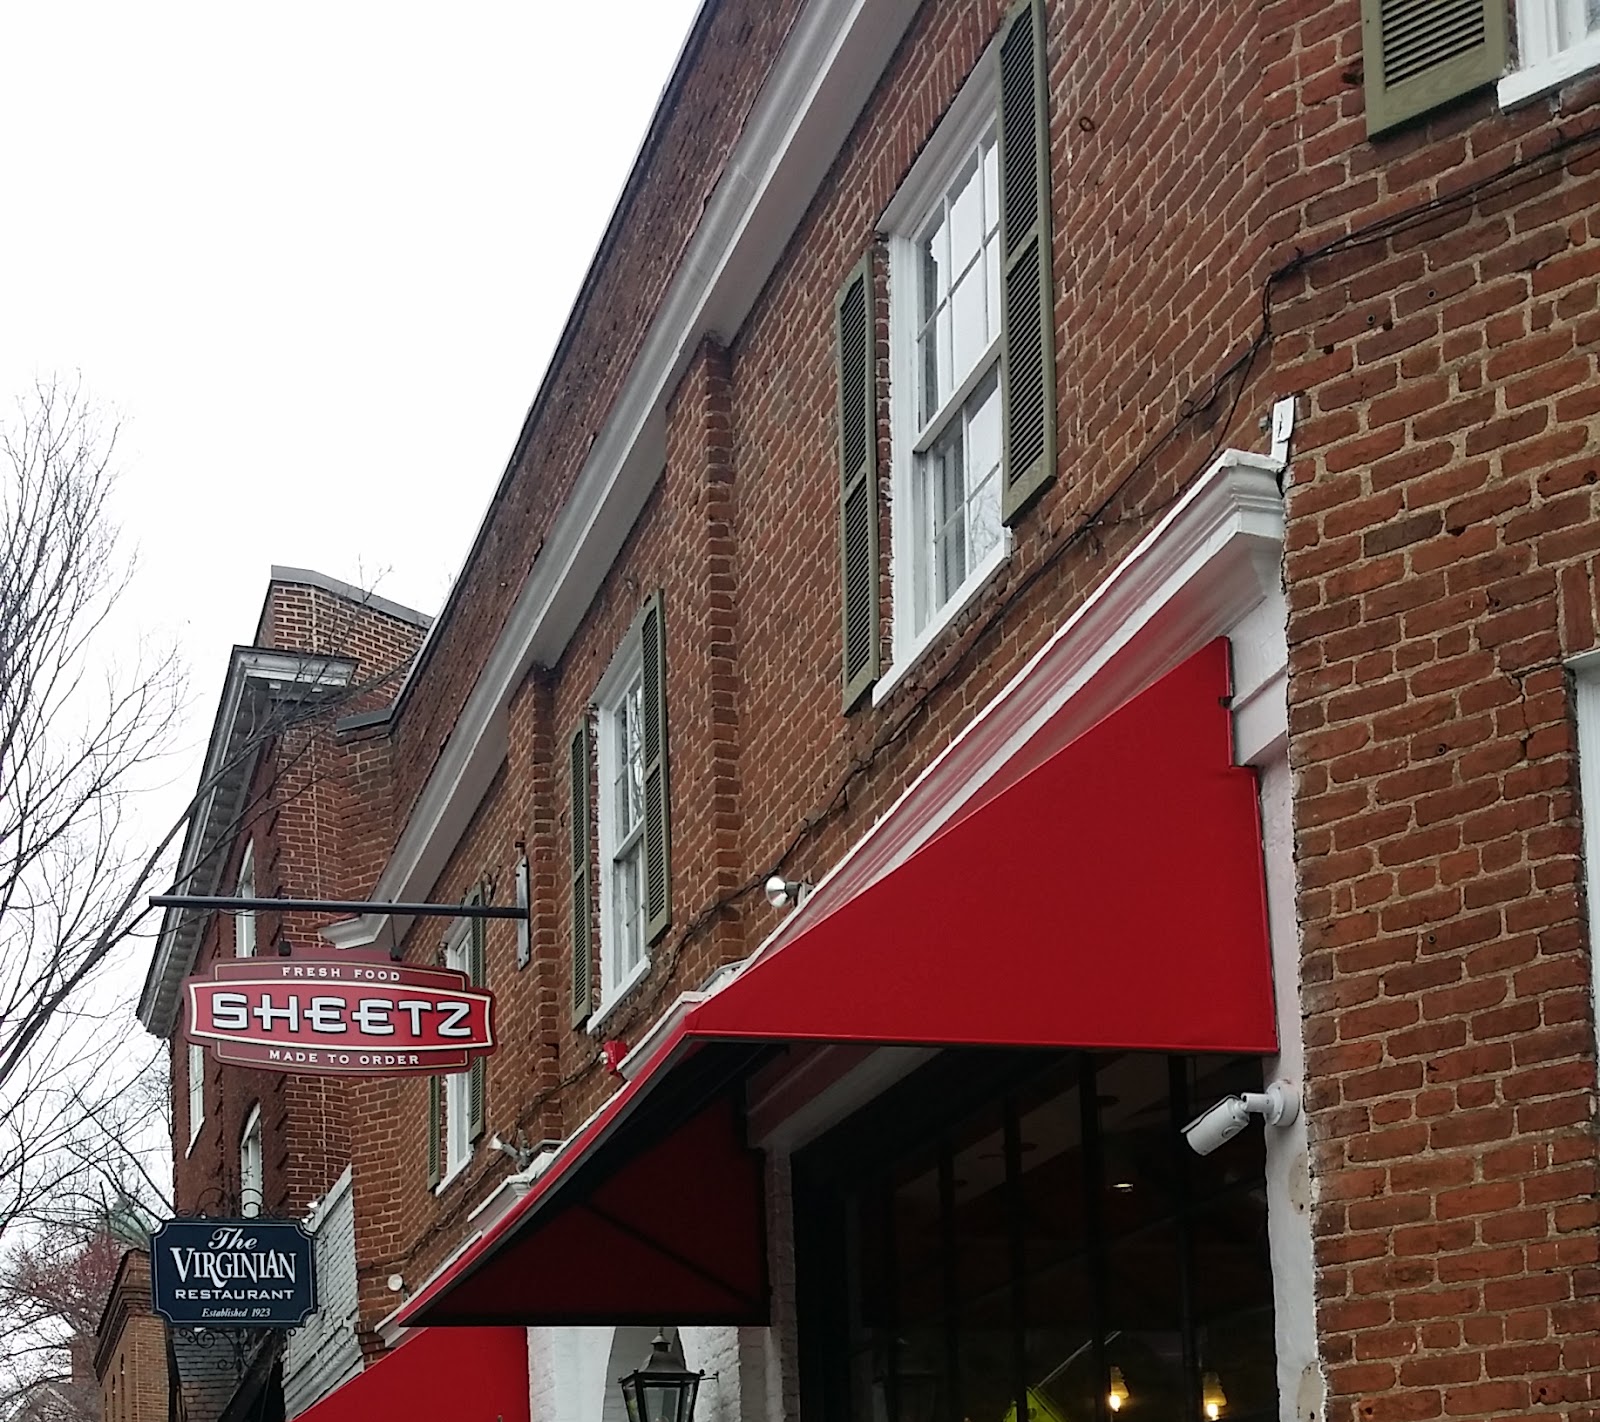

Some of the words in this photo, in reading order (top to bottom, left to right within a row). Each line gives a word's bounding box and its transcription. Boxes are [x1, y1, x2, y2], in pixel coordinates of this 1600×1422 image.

[282, 966, 341, 978] FRESH
[354, 969, 401, 982] FOOD
[212, 992, 472, 1037] SHEETZ
[269, 1050, 318, 1064] MADE
[328, 1053, 350, 1065] TO
[359, 1055, 420, 1065] ORDER
[208, 1227, 258, 1250] The
[169, 1247, 297, 1288] VIRGINIAN
[175, 1289, 295, 1300] RESTAURANT
[202, 1308, 248, 1318] Established
[251, 1308, 271, 1317] 1923
